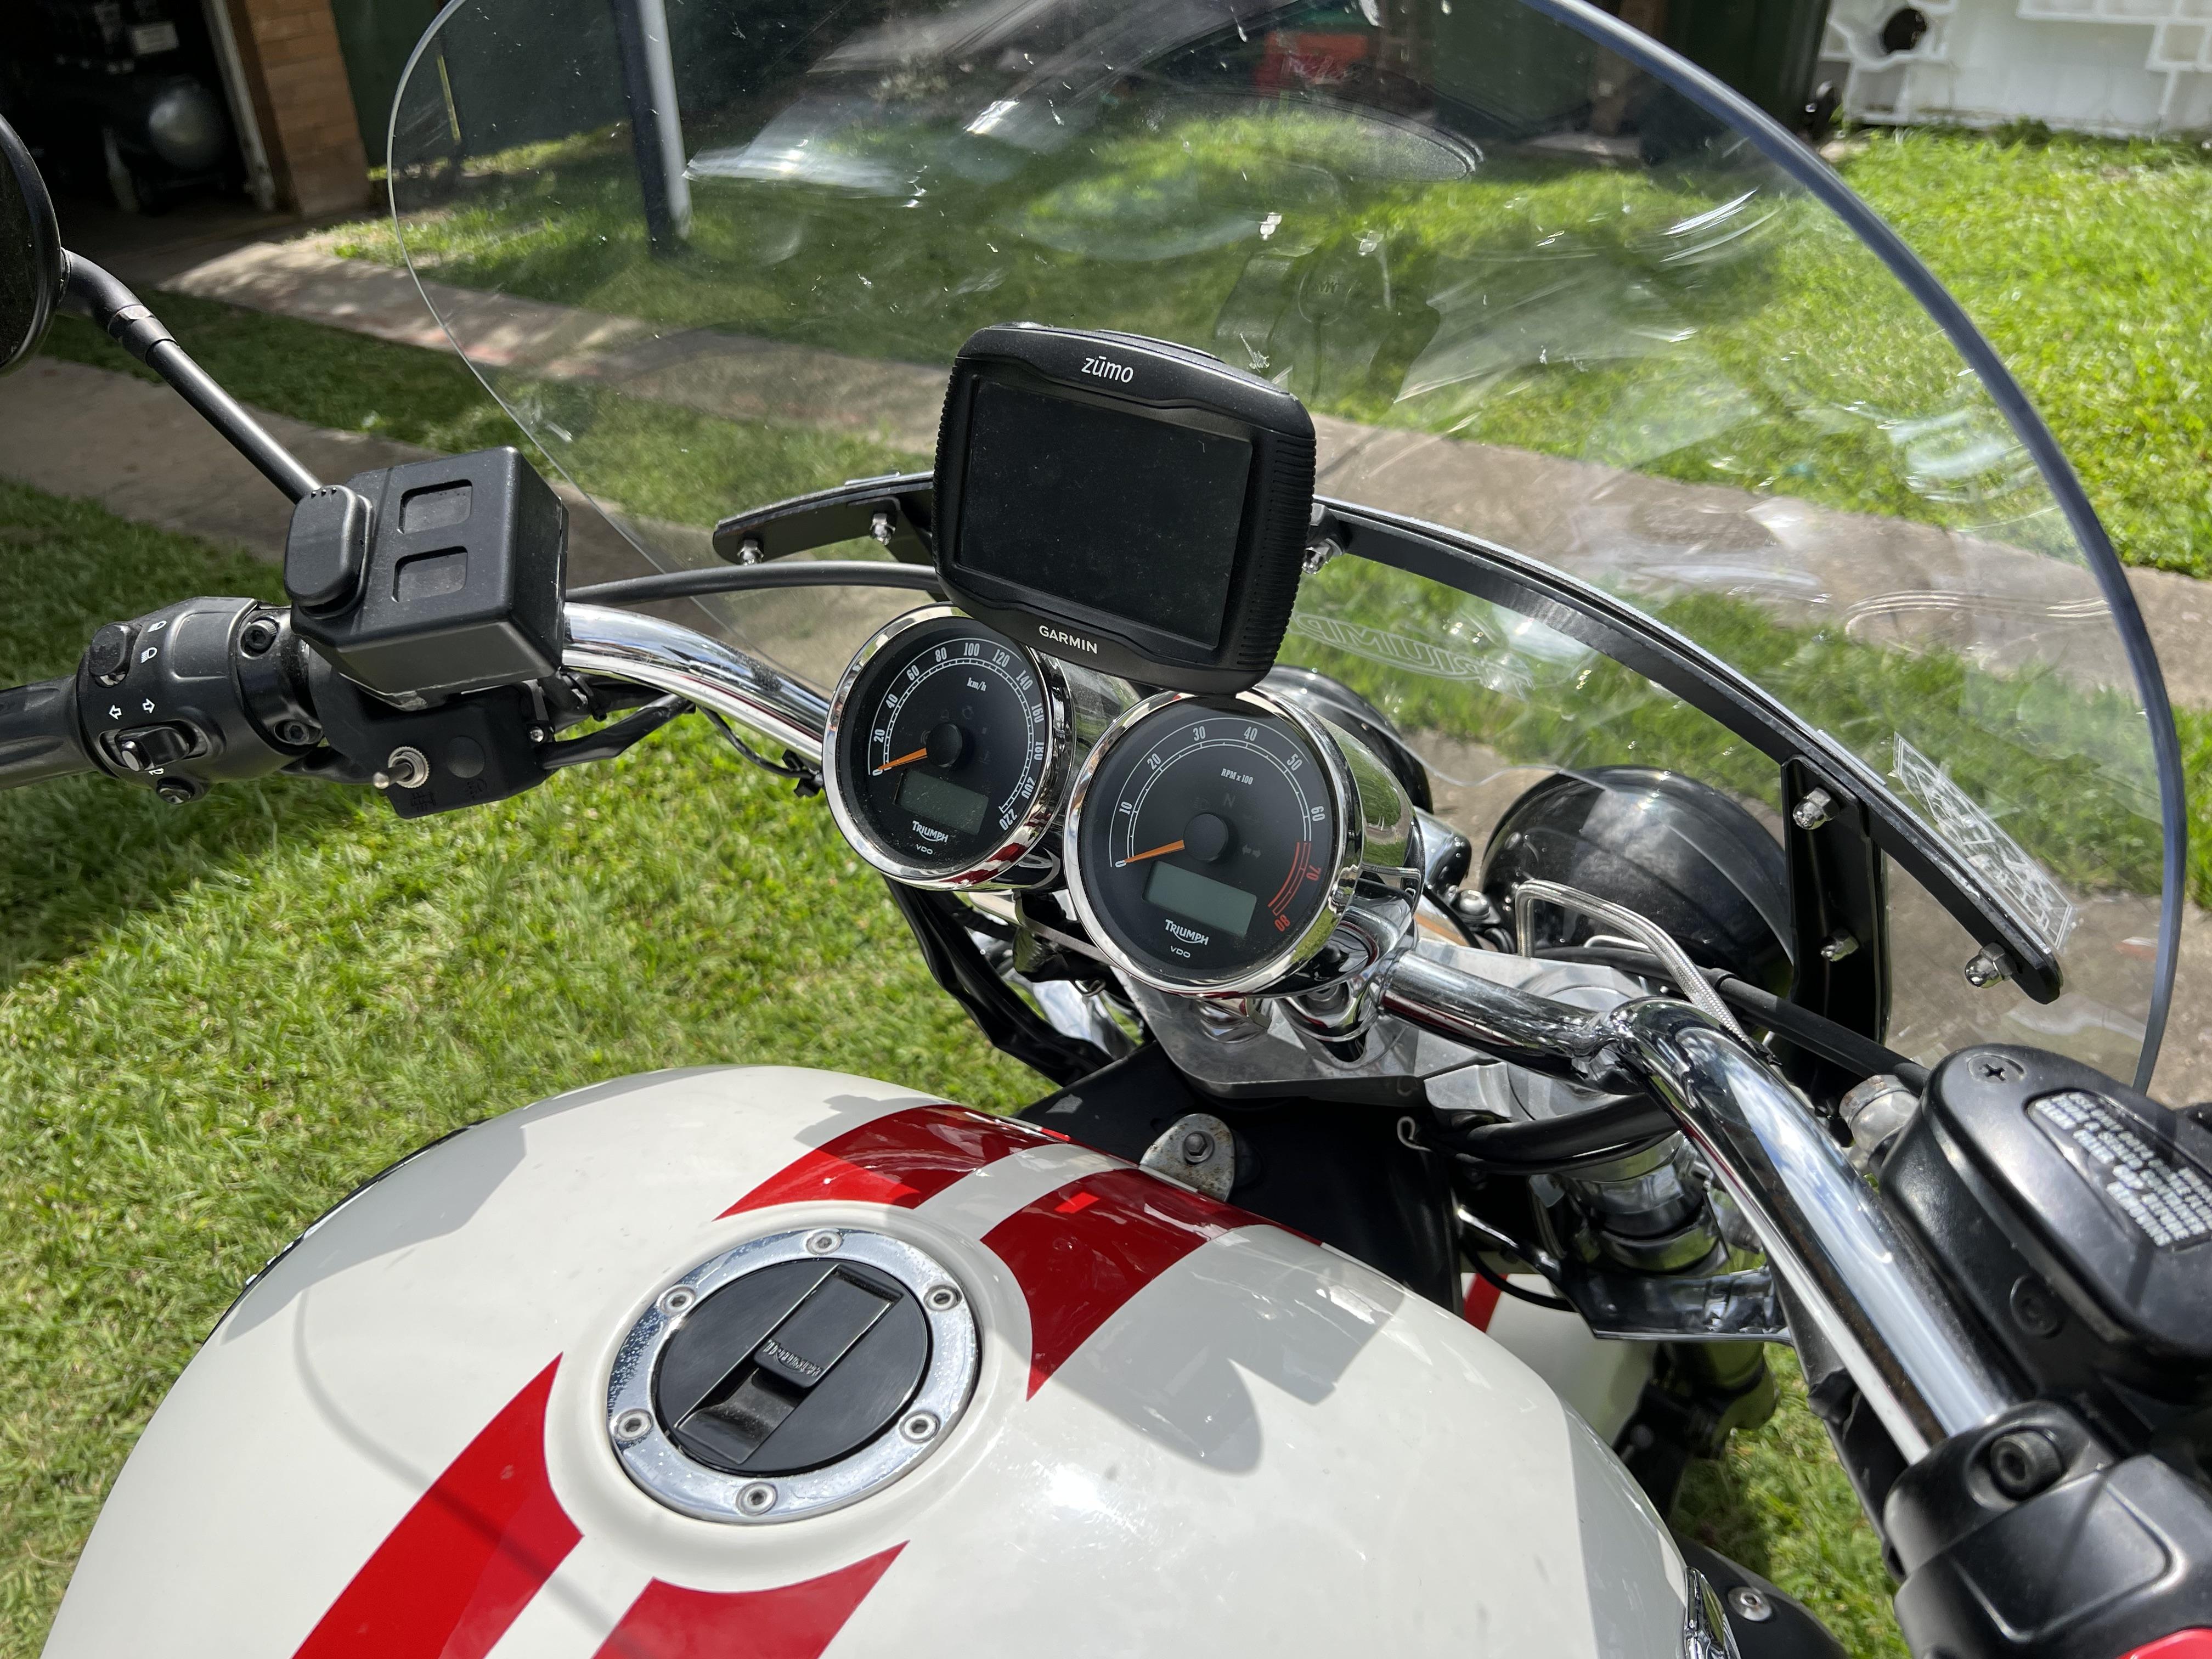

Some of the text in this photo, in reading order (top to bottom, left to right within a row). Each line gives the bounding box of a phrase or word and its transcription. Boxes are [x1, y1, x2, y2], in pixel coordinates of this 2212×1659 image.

[1039, 625, 1097, 654] GARMIN
[935, 647, 947, 662] 80
[963, 642, 980, 657] 100
[992, 649, 1010, 668] 120
[906, 664, 920, 681] 60
[1015, 670, 1033, 691] 140
[967, 677, 987, 691] km/h
[885, 693, 898, 709] 40
[1031, 702, 1045, 724] 160
[873, 729, 885, 743] 20
[1193, 726, 1206, 741] 30
[1244, 726, 1258, 741] 40
[1034, 741, 1045, 761] 180
[1147, 753, 1161, 770] 20
[1286, 753, 1303, 771] 50
[1221, 768, 1235, 780] RPM
[1241, 774, 1254, 785] 100
[1021, 776, 1036, 799] 200
[1119, 802, 1132, 815] 10
[1311, 805, 1325, 822] 60
[999, 808, 1018, 831] 220
[912, 820, 949, 843] TRIUMPH
[916, 844, 933, 855] VDO
[1306, 865, 1322, 881] 70
[1274, 914, 1290, 932] 80
[1165, 919, 1209, 946] TRIUMPH
[1170, 945, 1190, 958] VDO
[763, 1339, 822, 1377] TRIUMPH
